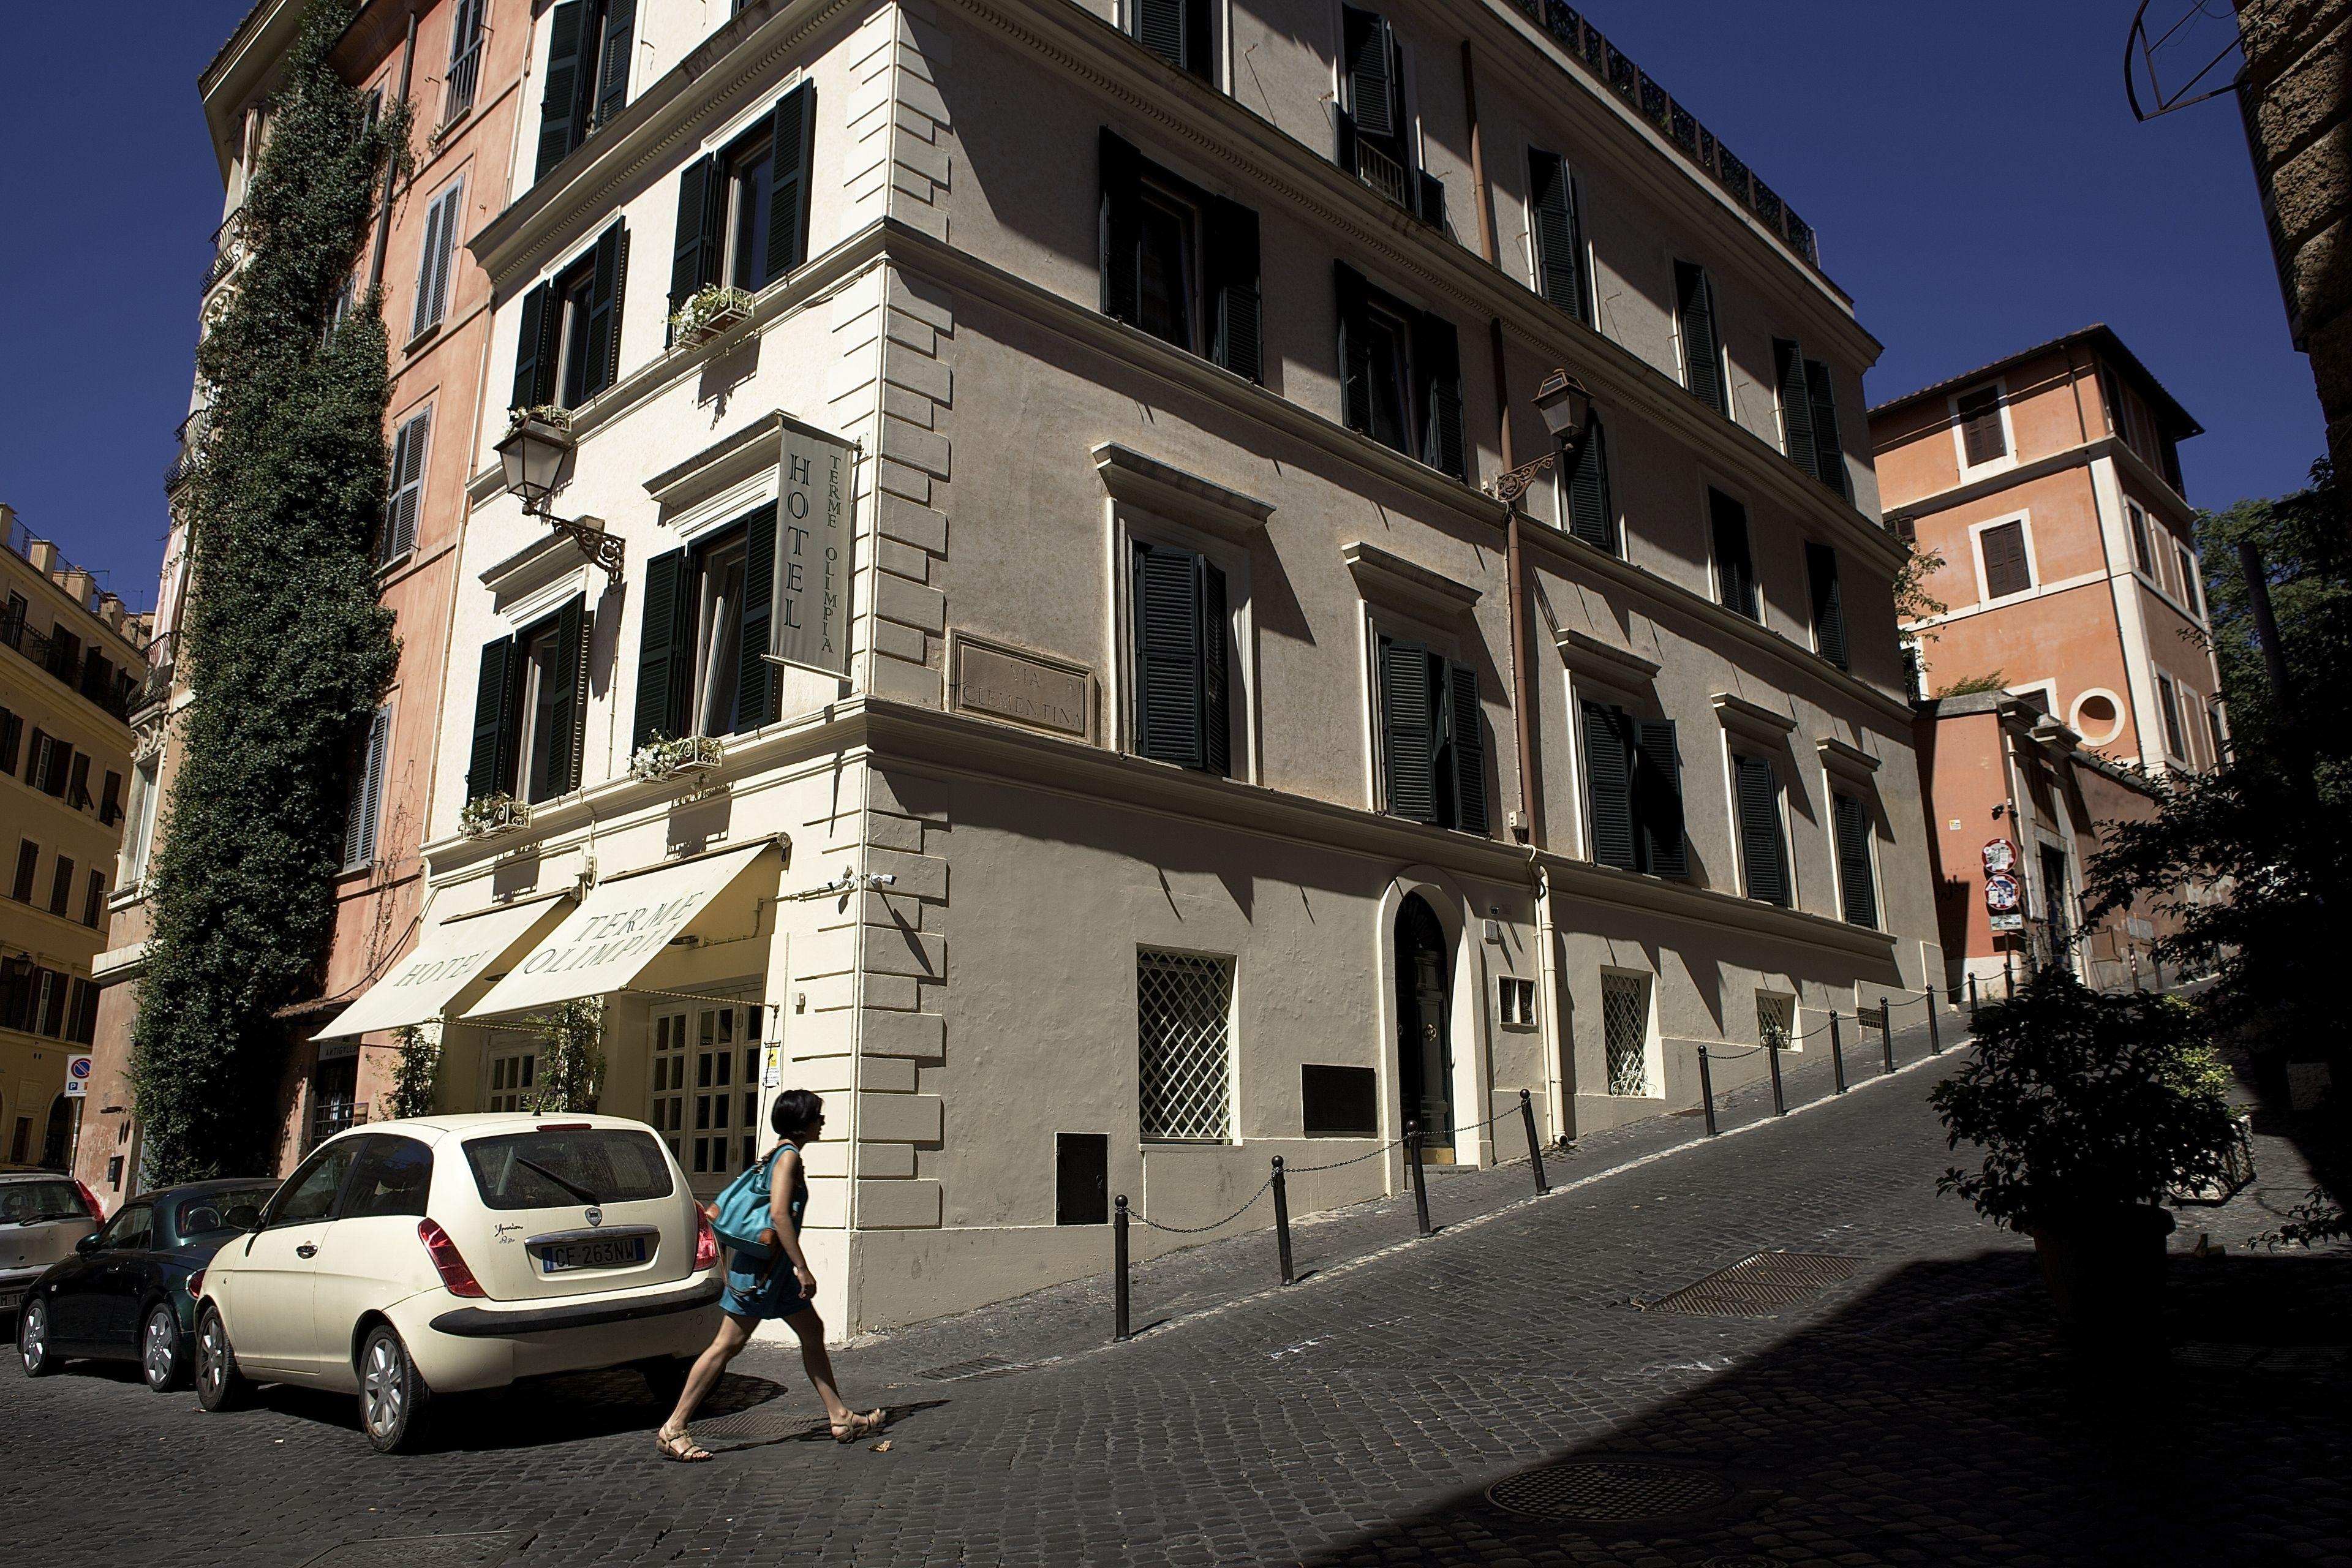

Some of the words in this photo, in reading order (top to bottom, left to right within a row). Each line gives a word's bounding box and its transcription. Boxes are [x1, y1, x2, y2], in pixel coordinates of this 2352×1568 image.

[827, 454, 842, 529] TERME
[783, 453, 812, 630] HOTEL
[821, 547, 838, 654] OLIMPIA
[1011, 665, 1040, 687] VIA
[963, 685, 1082, 728] CLEMENTINA
[573, 891, 705, 942] TERME
[393, 949, 491, 987] HOTEL
[524, 922, 680, 974] OLIMPIA
